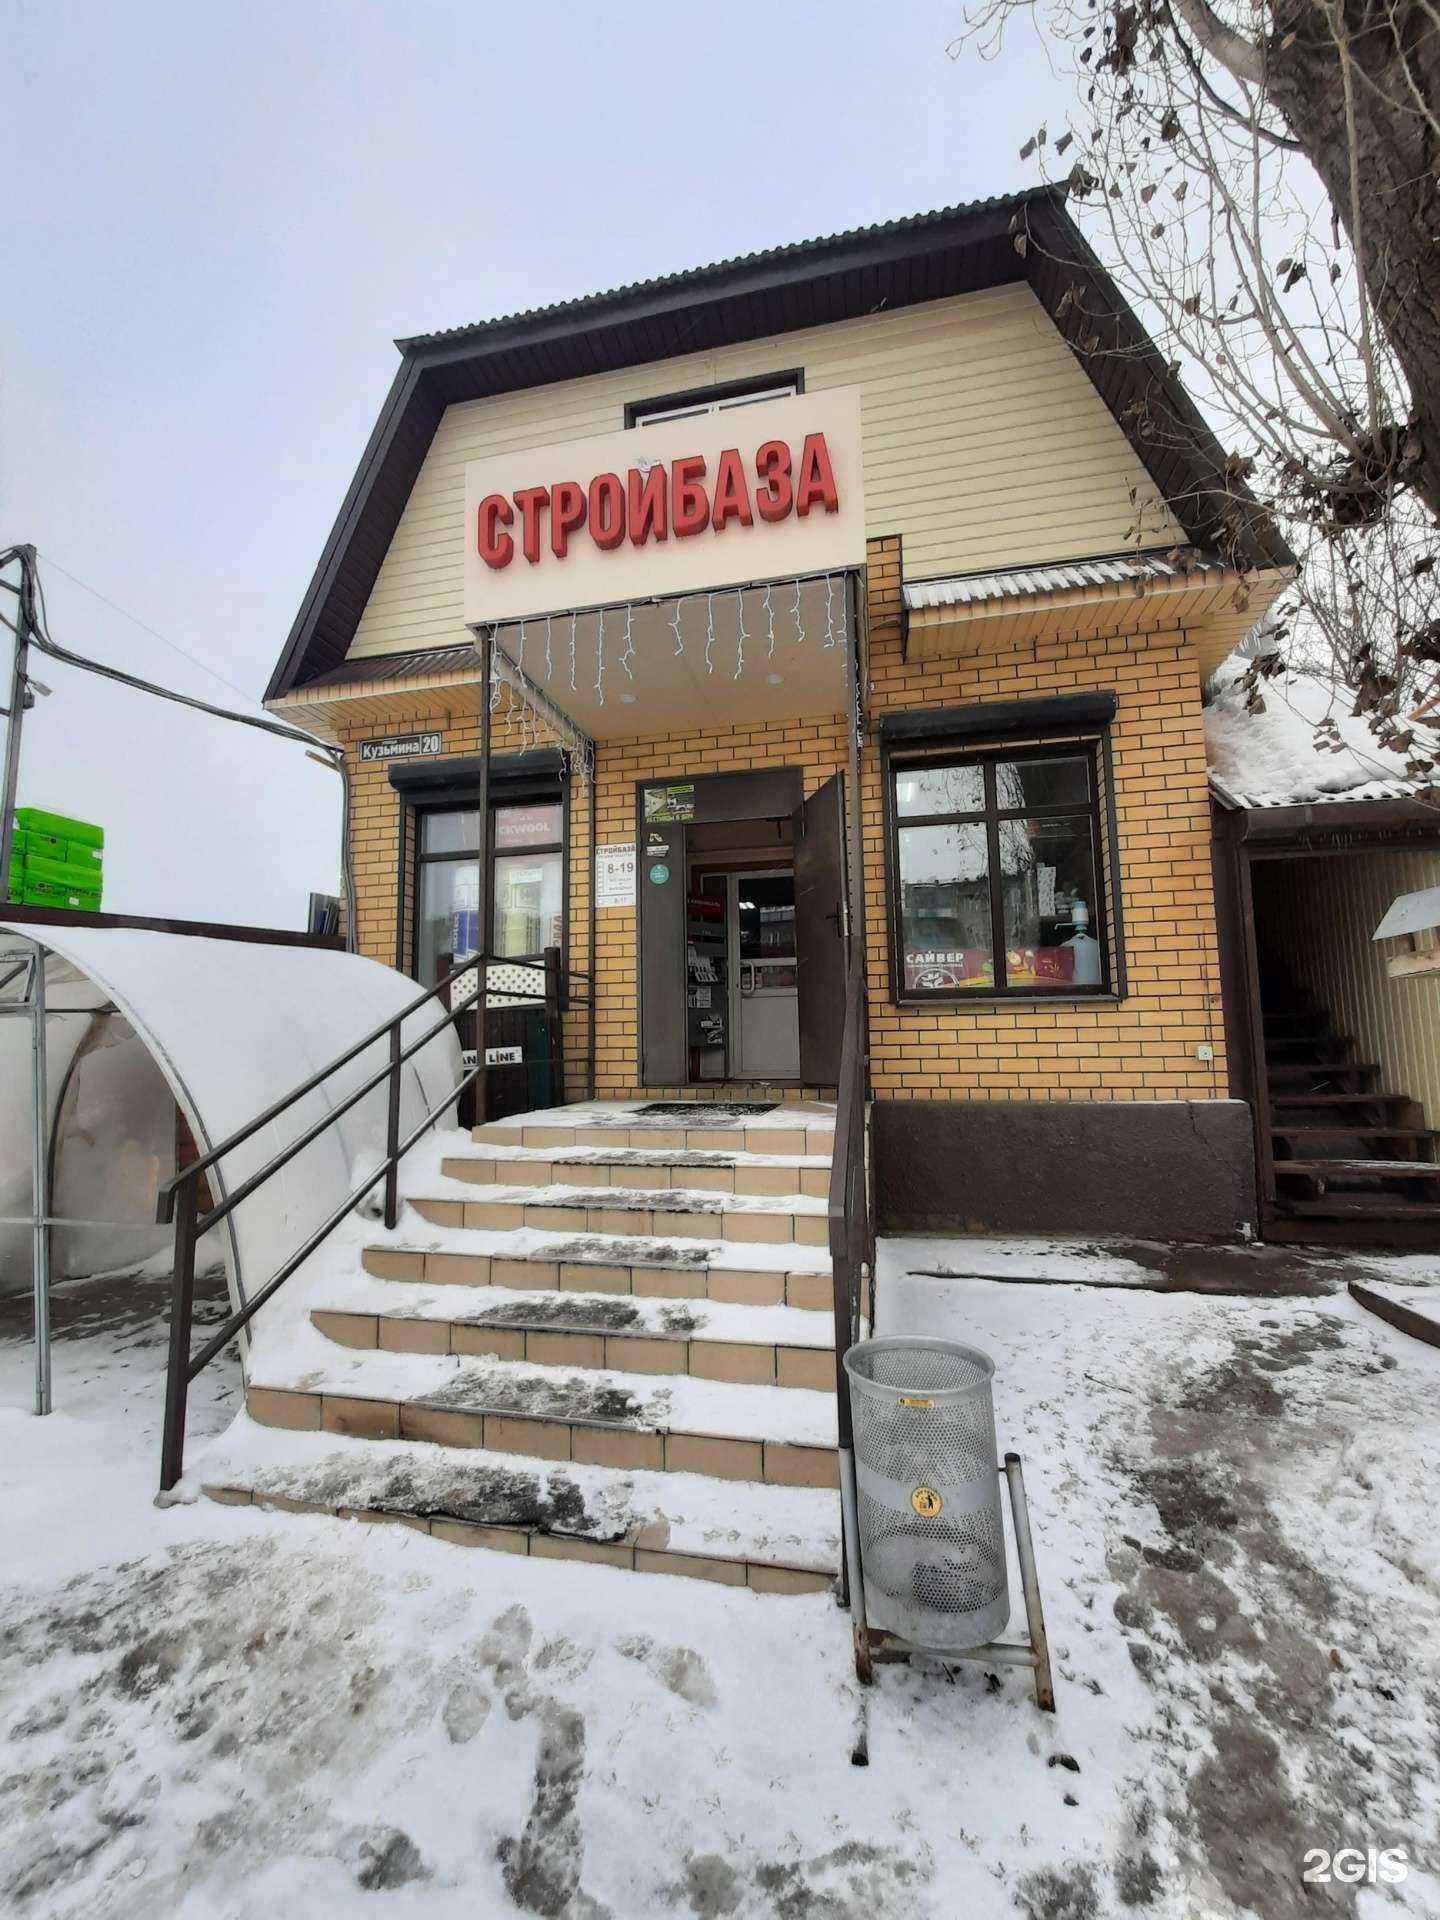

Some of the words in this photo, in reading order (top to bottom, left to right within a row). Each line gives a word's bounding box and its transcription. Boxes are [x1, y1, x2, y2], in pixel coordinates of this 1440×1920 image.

[477, 432, 839, 569] СТРОЙБАЗА
[362, 742, 420, 760] Кузьмина
[423, 735, 439, 753] 20
[607, 862, 634, 874] 8-19
